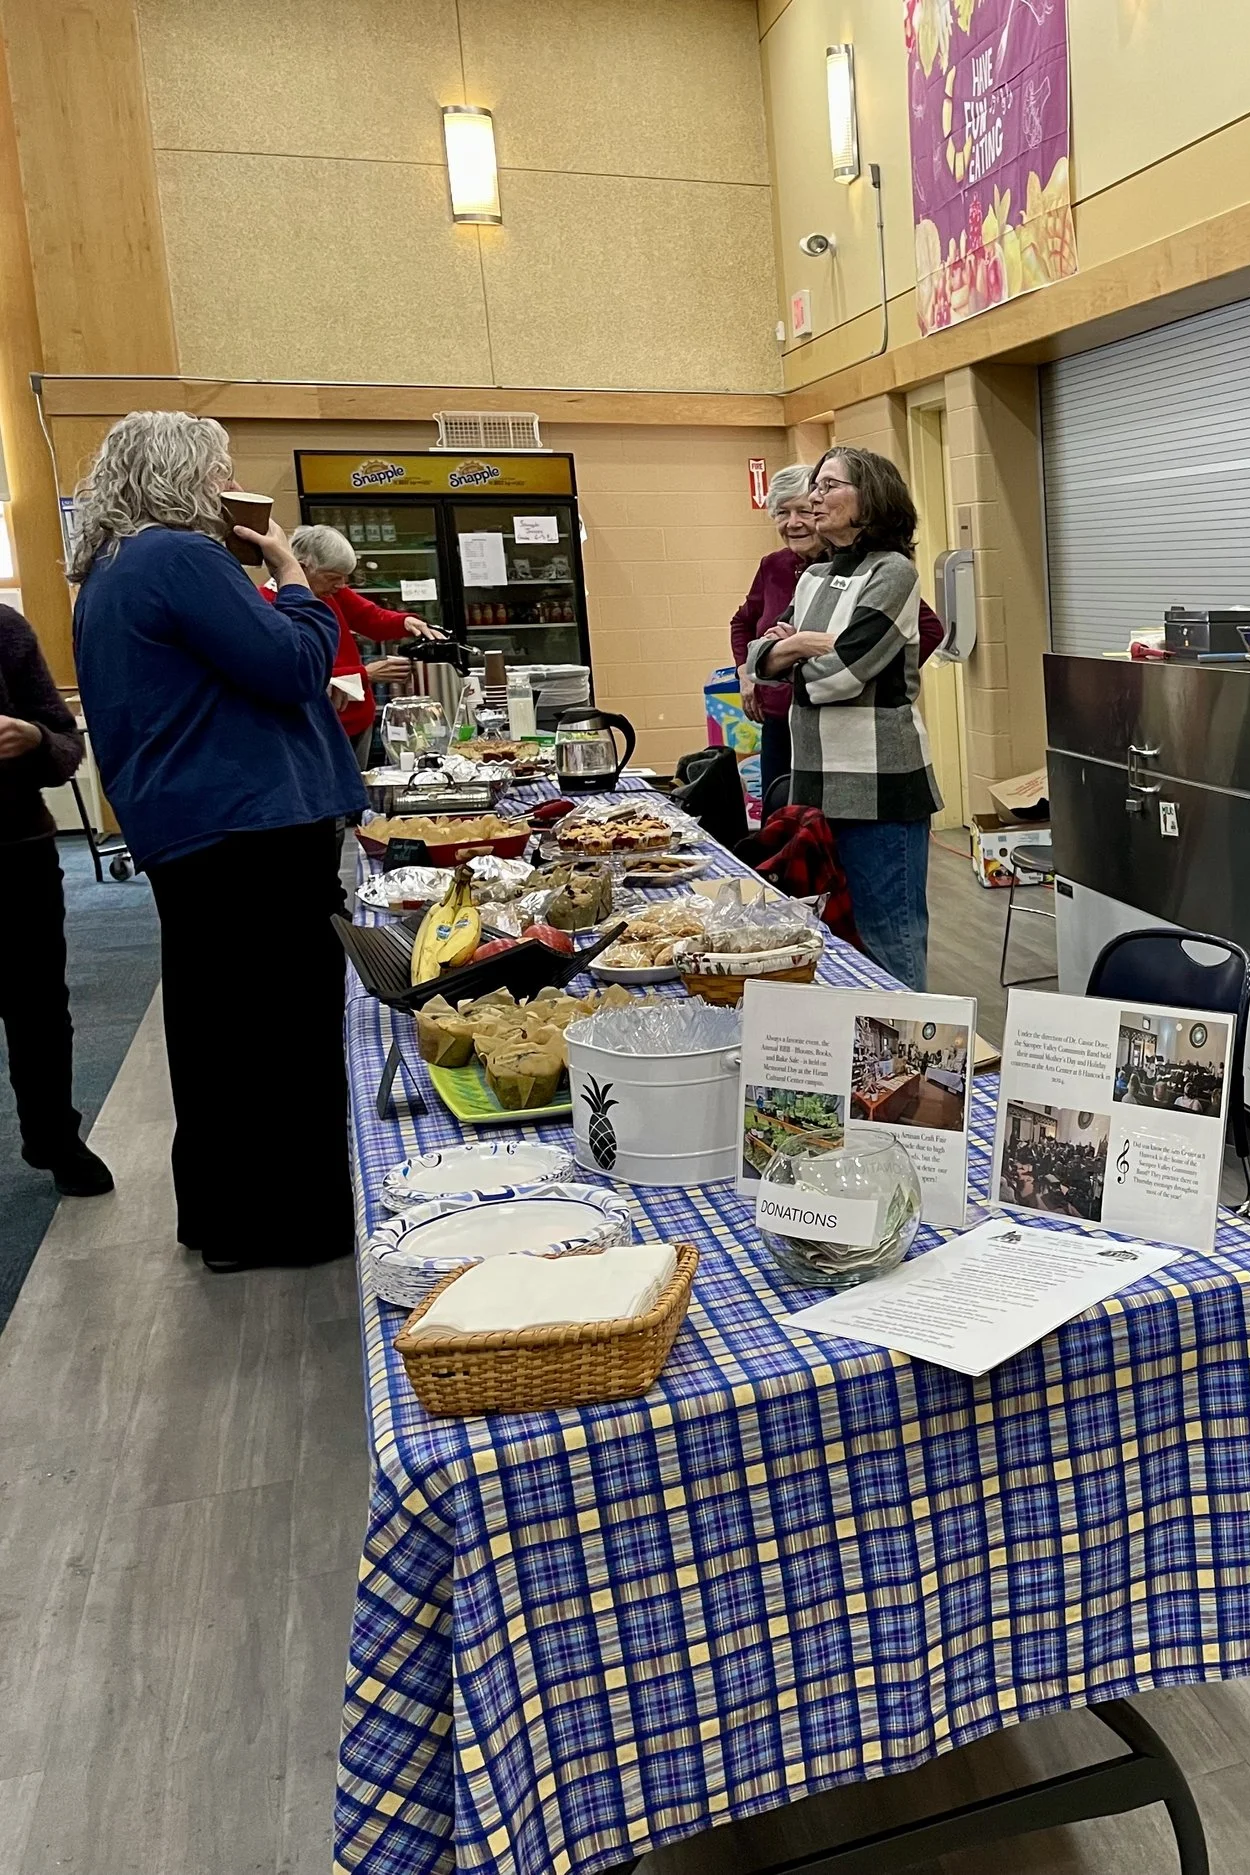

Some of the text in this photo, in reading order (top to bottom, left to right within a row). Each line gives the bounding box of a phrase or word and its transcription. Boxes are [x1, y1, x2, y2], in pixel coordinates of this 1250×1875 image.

[972, 47, 993, 96] HAVE
[964, 98, 987, 141] FUN
[969, 117, 1003, 184] EATING
[352, 465, 499, 488] Snapple Snapple
[761, 1200, 837, 1228] DONATIONS
